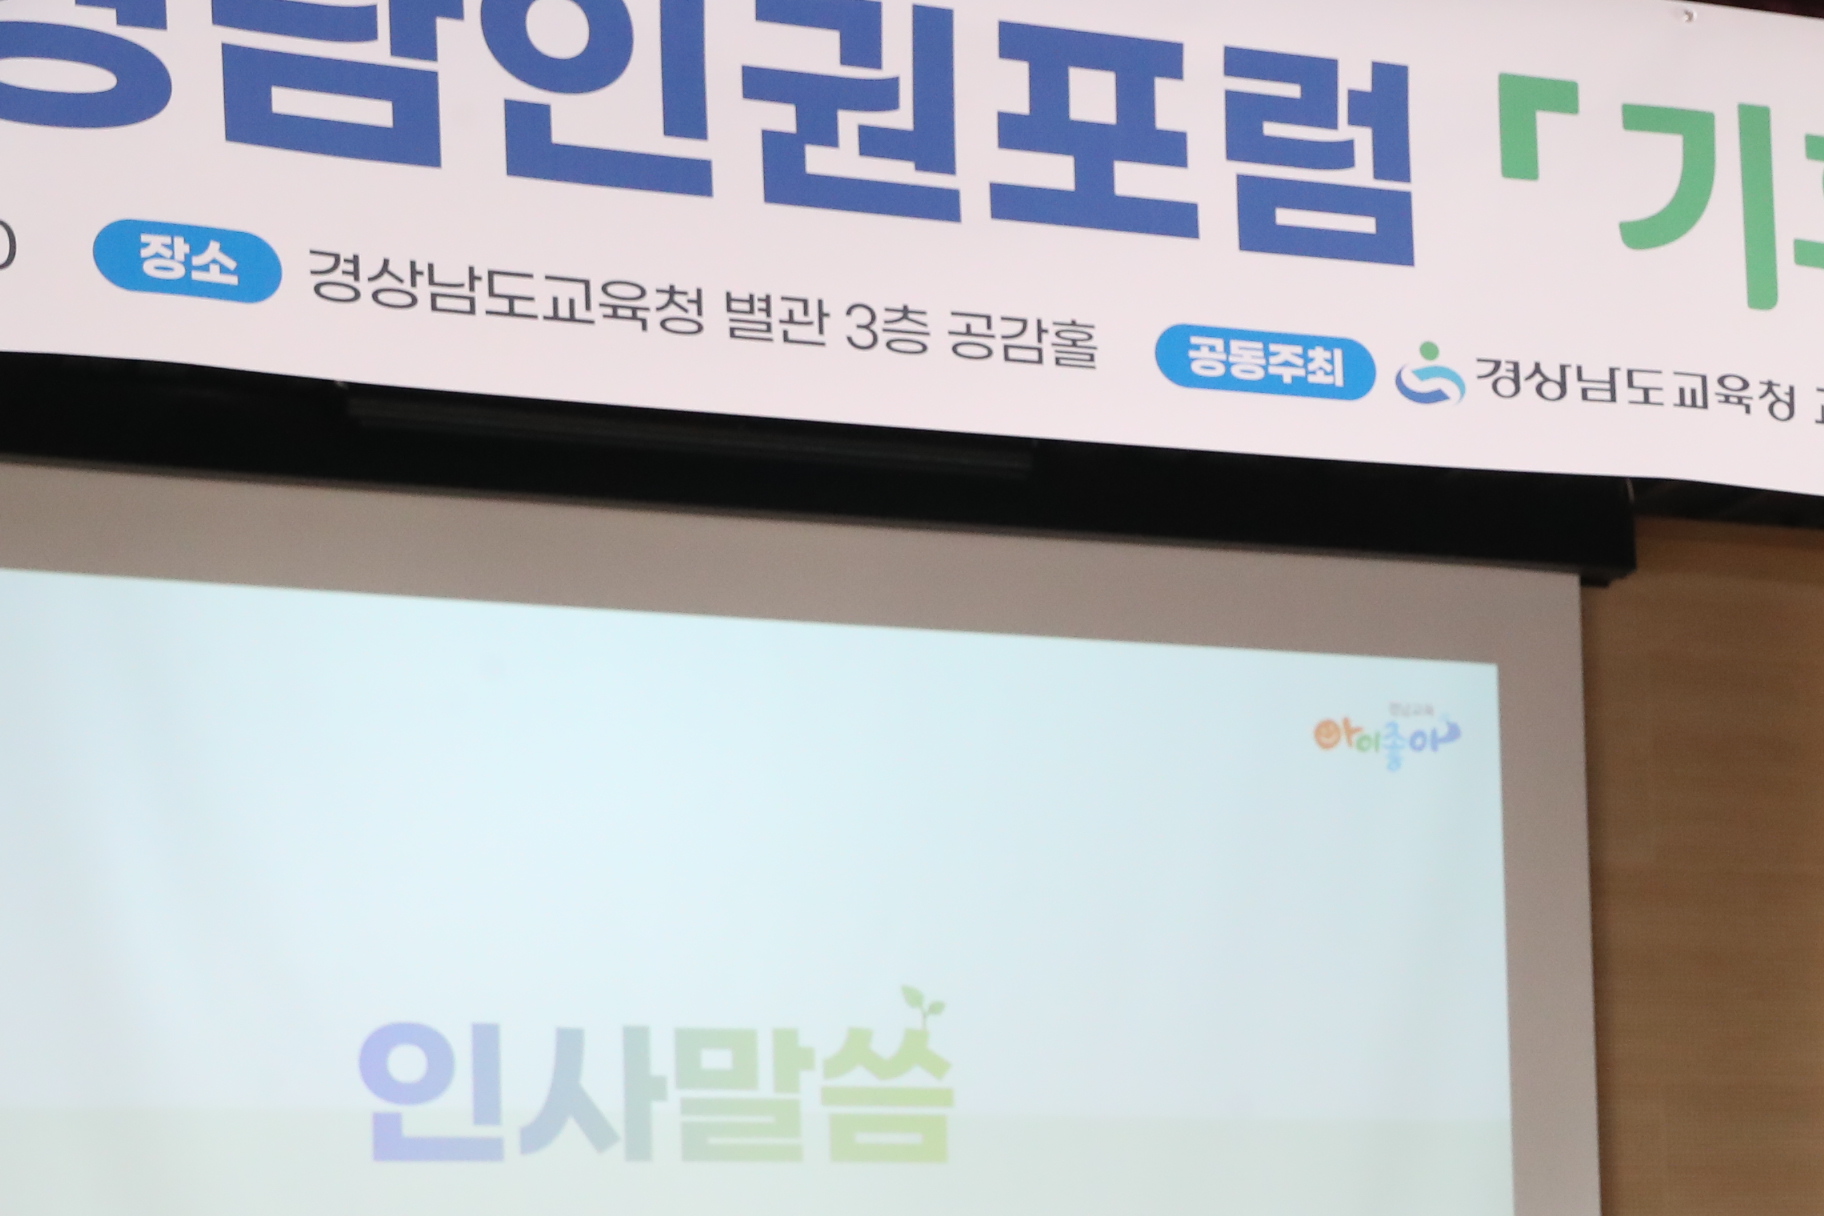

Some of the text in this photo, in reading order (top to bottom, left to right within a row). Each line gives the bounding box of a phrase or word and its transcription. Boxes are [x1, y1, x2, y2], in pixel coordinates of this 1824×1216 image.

[139, 232, 240, 287] 장소
[309, 248, 1099, 370] 경상남도교육청 별관 3층 공감홀
[1188, 335, 1345, 389] 공동주최
[1475, 356, 1797, 423] 경상남도교육청
[1313, 716, 1463, 773] 아이좋아
[357, 1018, 956, 1165] 인사말씀
